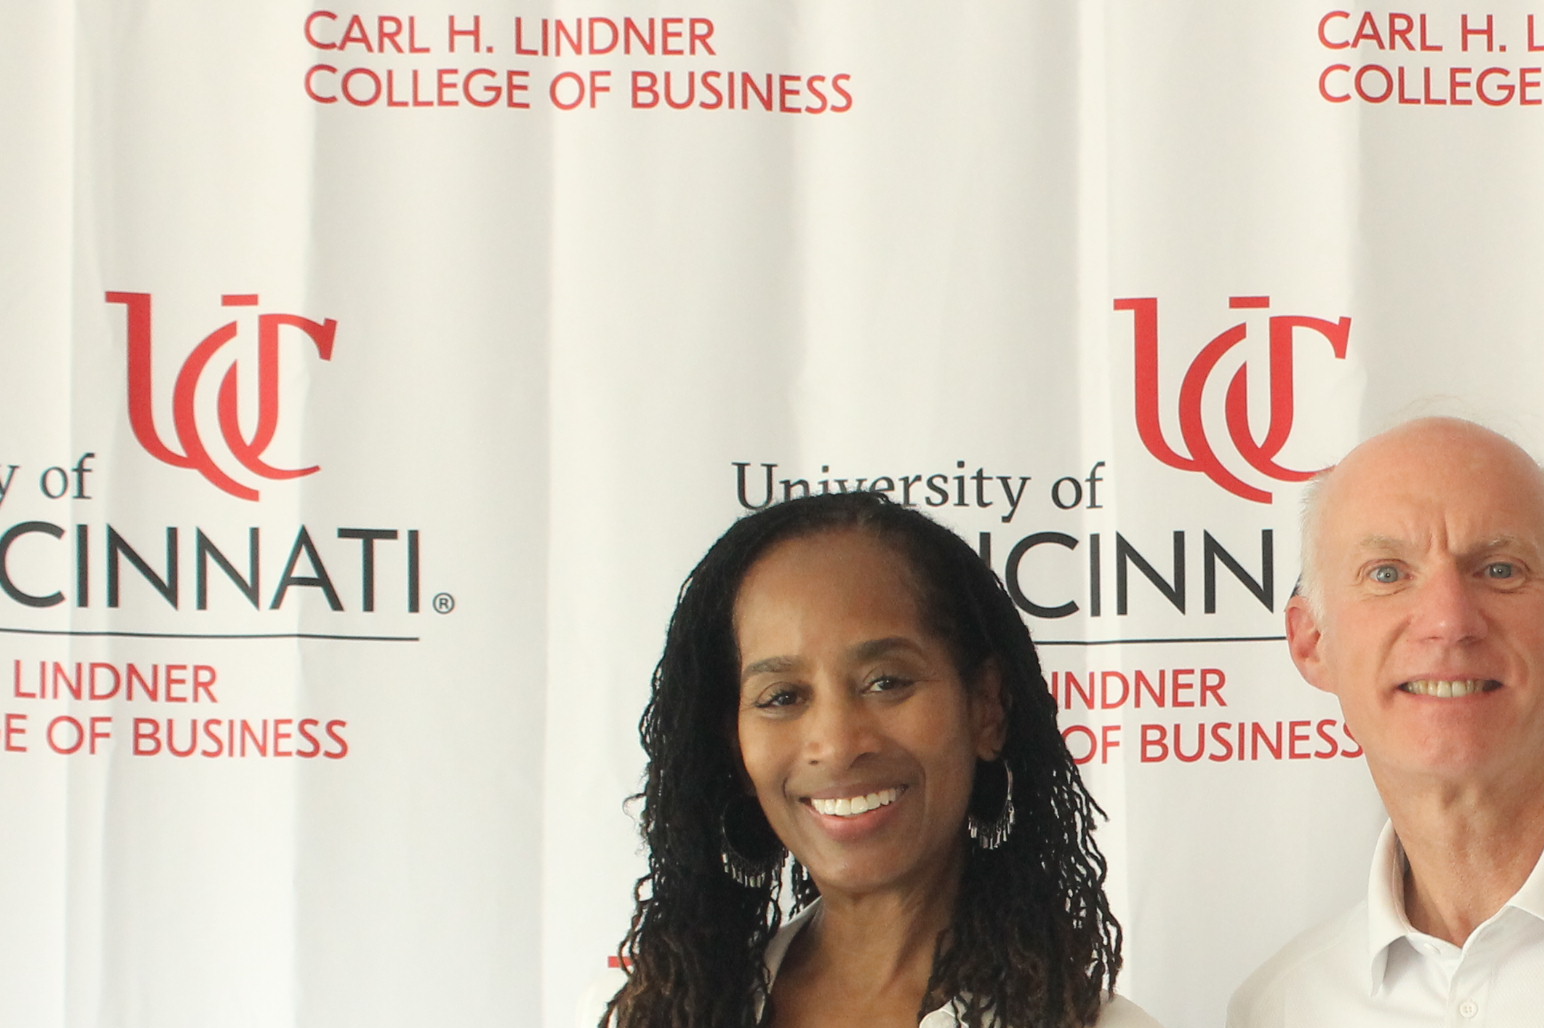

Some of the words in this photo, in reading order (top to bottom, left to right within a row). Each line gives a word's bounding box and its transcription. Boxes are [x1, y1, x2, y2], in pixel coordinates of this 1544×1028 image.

[304, 10, 432, 55] CARL
[448, 15, 495, 54] H.
[515, 16, 717, 57] LINDNER
[1317, 10, 1445, 52] CARL
[1461, 14, 1508, 53] H.
[304, 63, 532, 110] COLLEGE
[549, 70, 613, 112] OF
[631, 70, 854, 115] BUSINESS
[1319, 63, 1544, 107] COLLEGE
[40, 452, 96, 500] of
[1051, 460, 1106, 510] of
[14, 659, 219, 704] LINDNER
[46, 715, 114, 756] OF
[133, 717, 350, 760] BUSINESS
[1061, 724, 1122, 766] OF
[1140, 718, 1364, 764] BUSINESS
